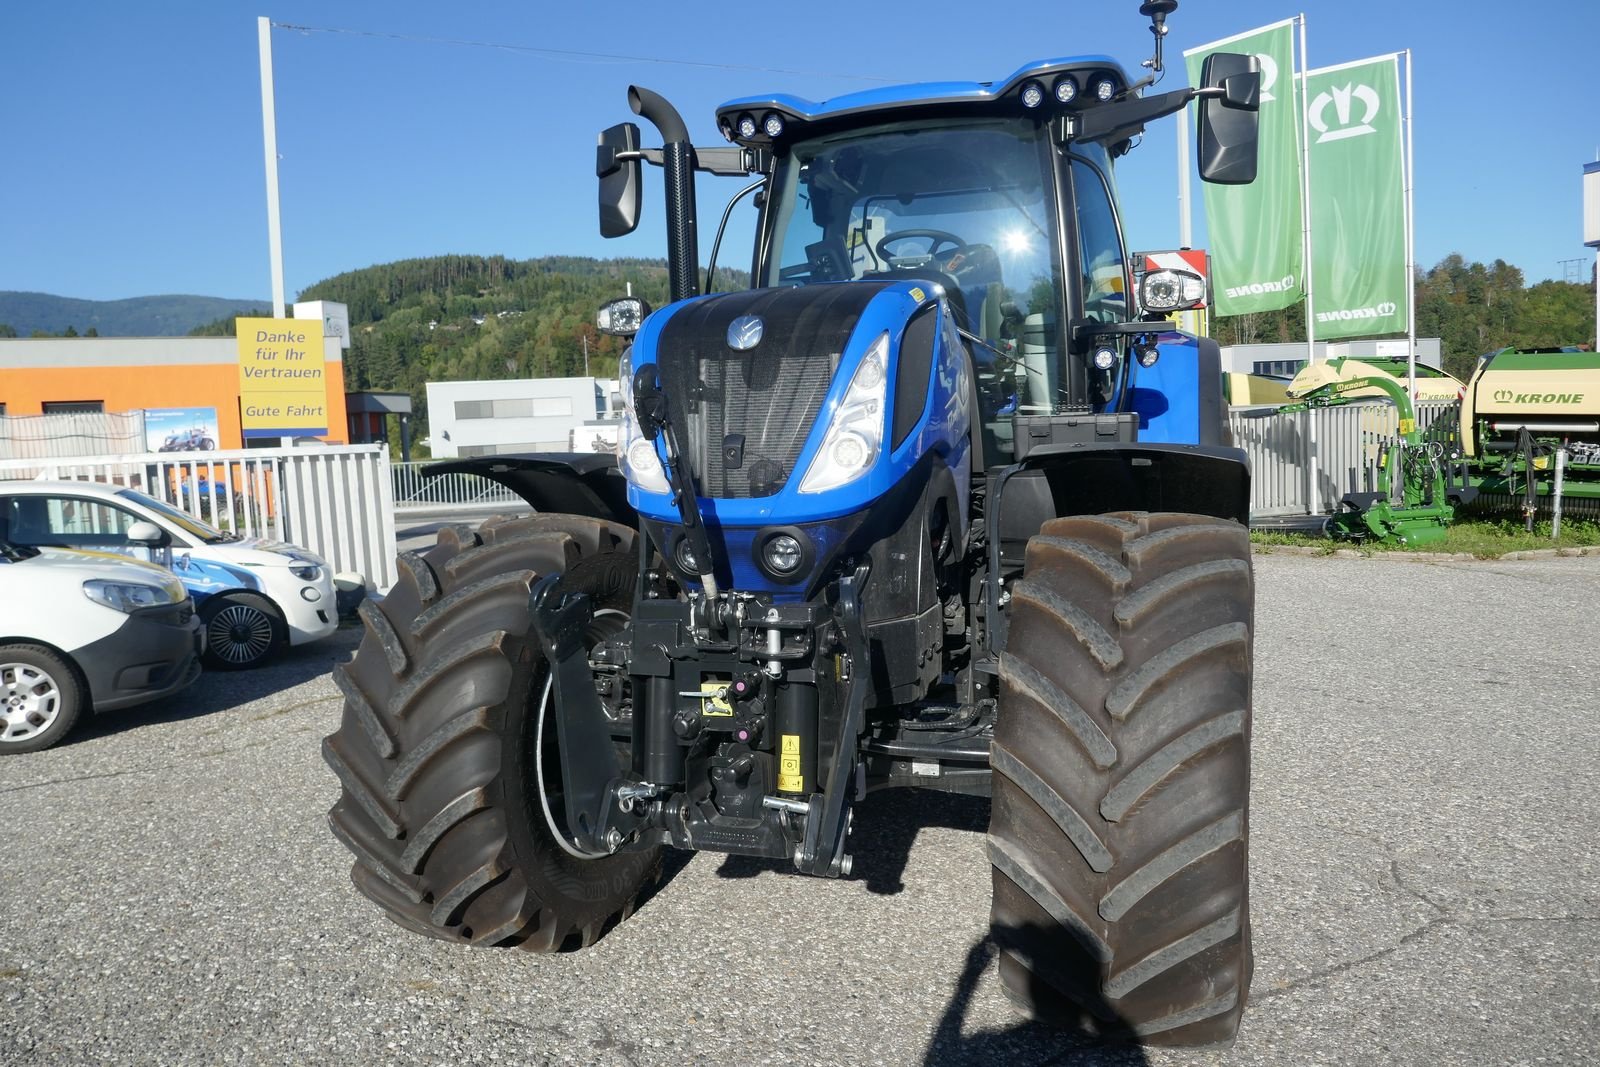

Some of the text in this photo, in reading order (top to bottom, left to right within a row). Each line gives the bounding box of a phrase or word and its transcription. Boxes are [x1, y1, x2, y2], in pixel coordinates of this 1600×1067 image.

[256, 330, 305, 343] Danke
[256, 348, 306, 360] für Ihr
[243, 366, 322, 378] Vertrauen
[1344, 379, 1369, 391] KRONE
[1514, 394, 1584, 404] KRONE
[245, 404, 323, 417] Gute Fahrt
